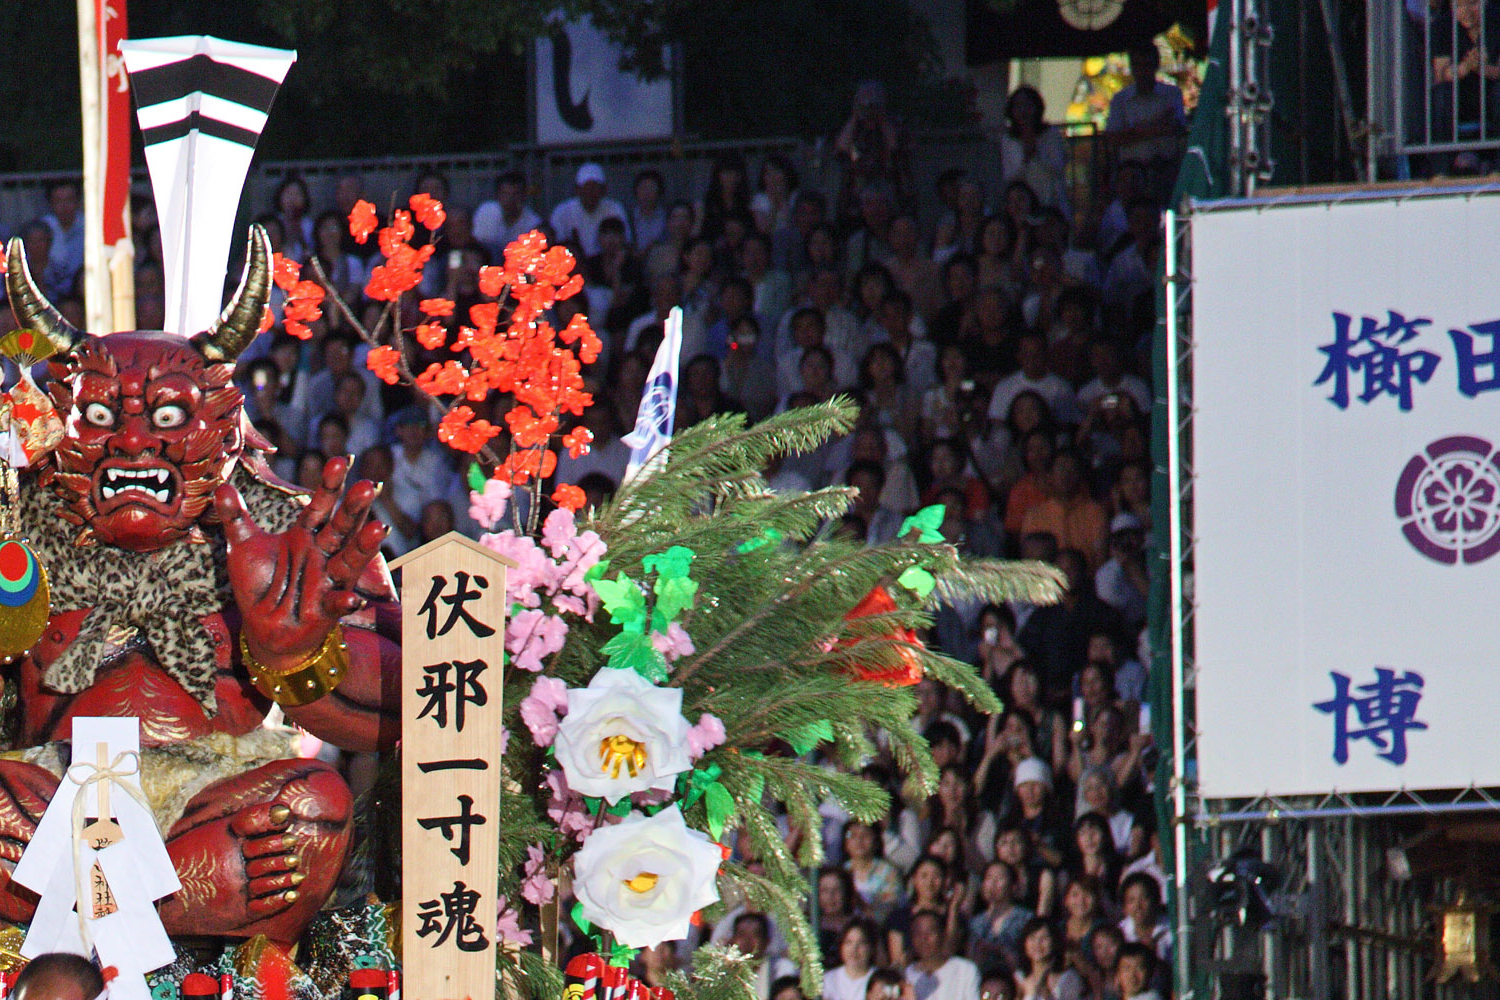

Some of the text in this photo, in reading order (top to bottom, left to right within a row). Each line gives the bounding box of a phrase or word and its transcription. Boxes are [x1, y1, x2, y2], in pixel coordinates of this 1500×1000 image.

[1312, 310, 1500, 412] 櫛田
[415, 570, 496, 953] 伏邪一寸魂
[1311, 666, 1429, 766] 博
